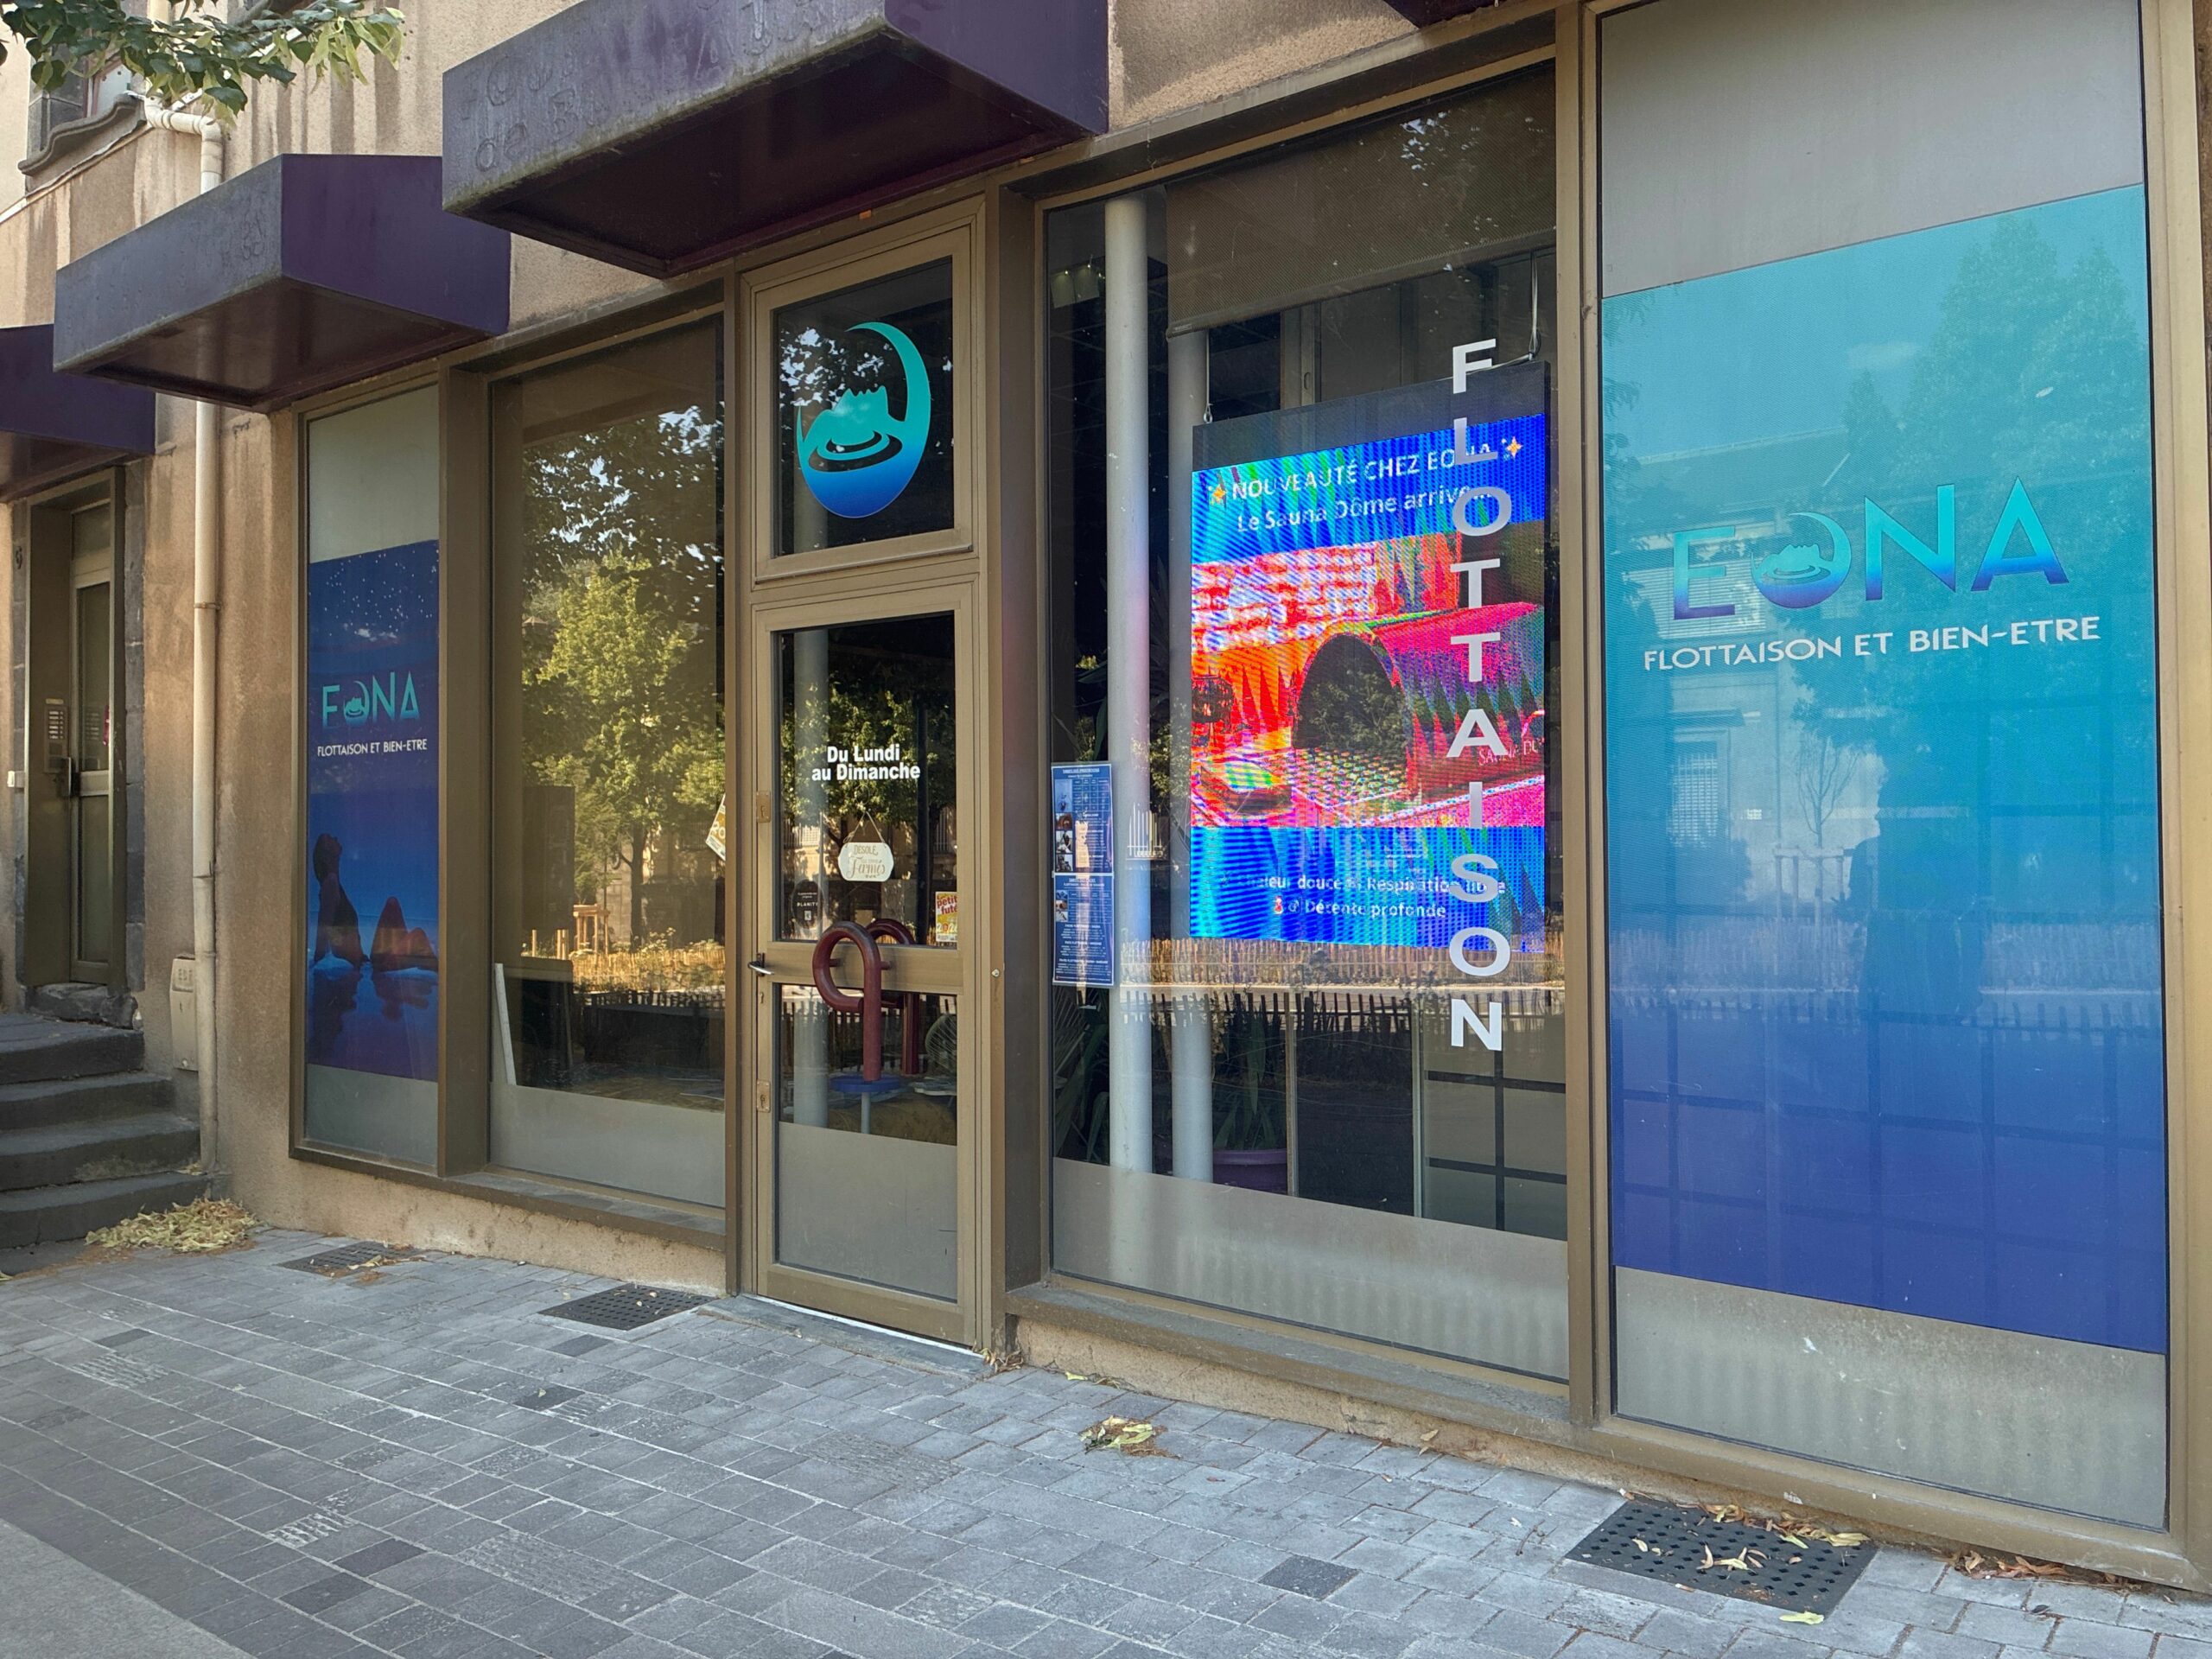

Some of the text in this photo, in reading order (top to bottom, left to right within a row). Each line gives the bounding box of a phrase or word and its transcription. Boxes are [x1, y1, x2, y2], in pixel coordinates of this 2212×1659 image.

[1232, 442, 1491, 500] NOUVEAUTÉ CHEZ EOA
[1237, 516, 1260, 532] Le
[1265, 507, 1327, 530] Sauna
[1334, 496, 1397, 519] Dôme
[1673, 475, 2069, 620] EONA
[1643, 616, 2101, 671] FLOTTAISON ET BIEN-ETRE
[1446, 338, 1511, 1052] FLOTTAISON
[317, 738, 428, 757] FLOTTAISON ET BIEN-ETRE
[827, 743, 900, 762] Du Lundi
[811, 761, 921, 781] au Dimanche
[1298, 874, 1342, 890] douce
[937, 894, 957, 908] petit
[1371, 902, 1446, 918] profonde
